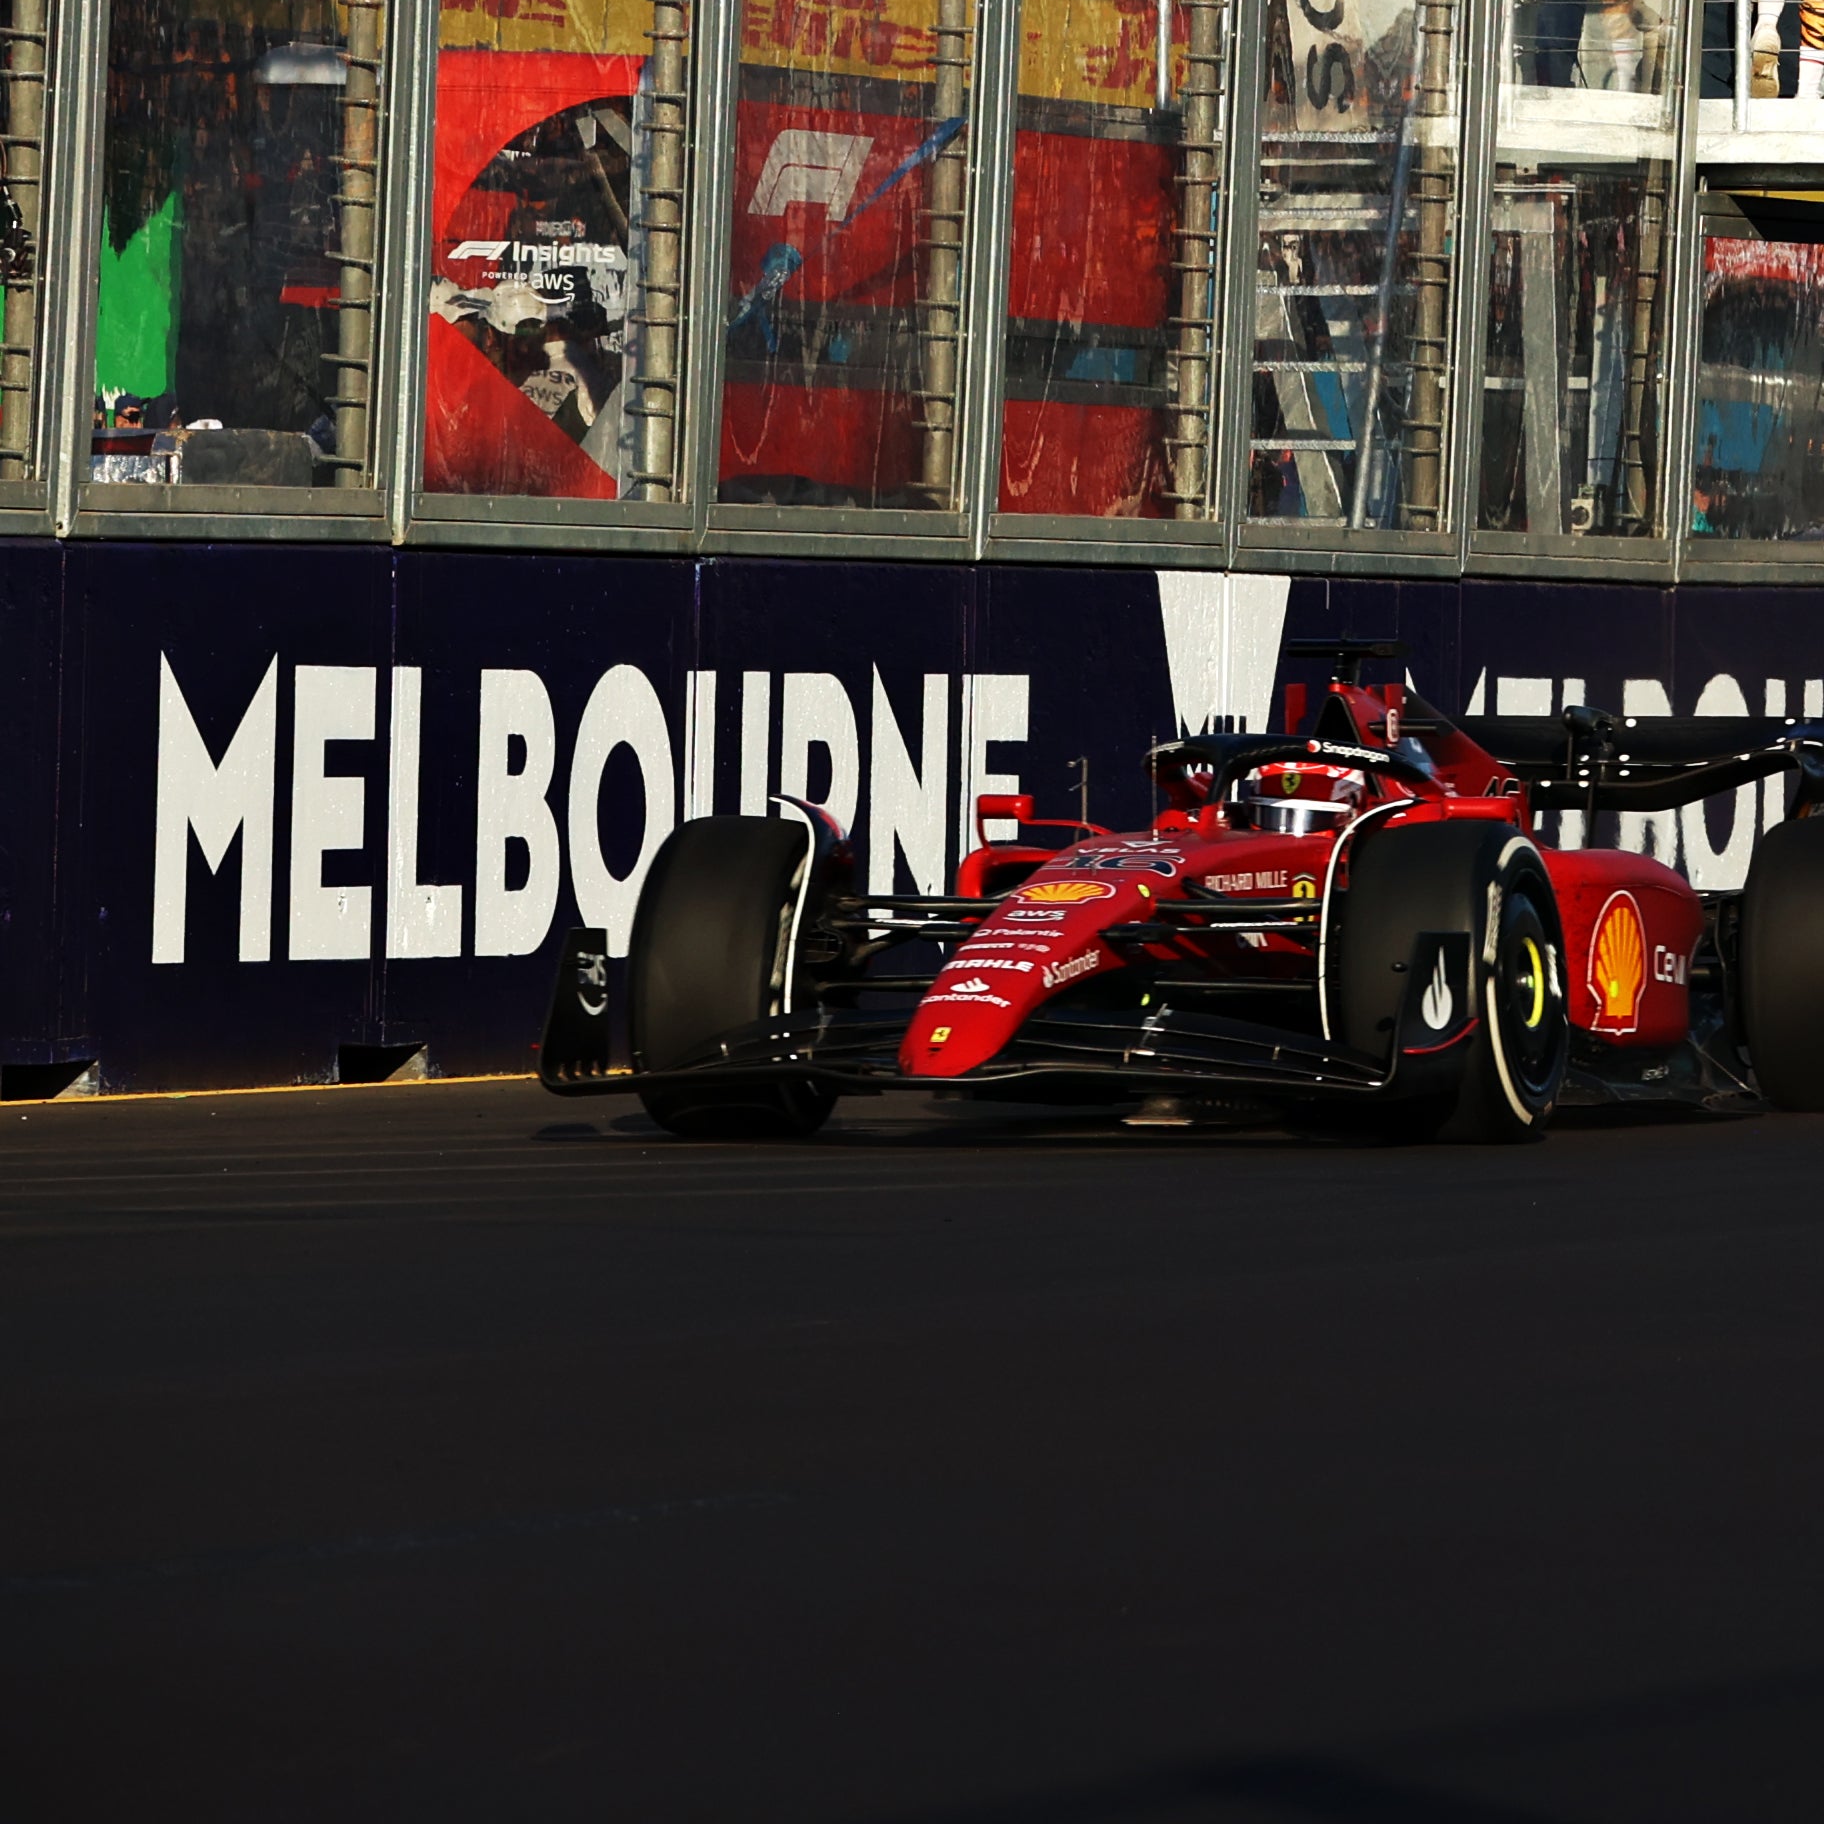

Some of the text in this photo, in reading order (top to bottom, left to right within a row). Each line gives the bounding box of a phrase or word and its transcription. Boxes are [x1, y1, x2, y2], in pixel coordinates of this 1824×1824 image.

[513, 241, 617, 267] Insights
[532, 273, 575, 293] aws
[1322, 741, 1390, 763] Snapdragon
[1204, 870, 1288, 891] RICHARD MILLE
[1007, 909, 1067, 919] aws
